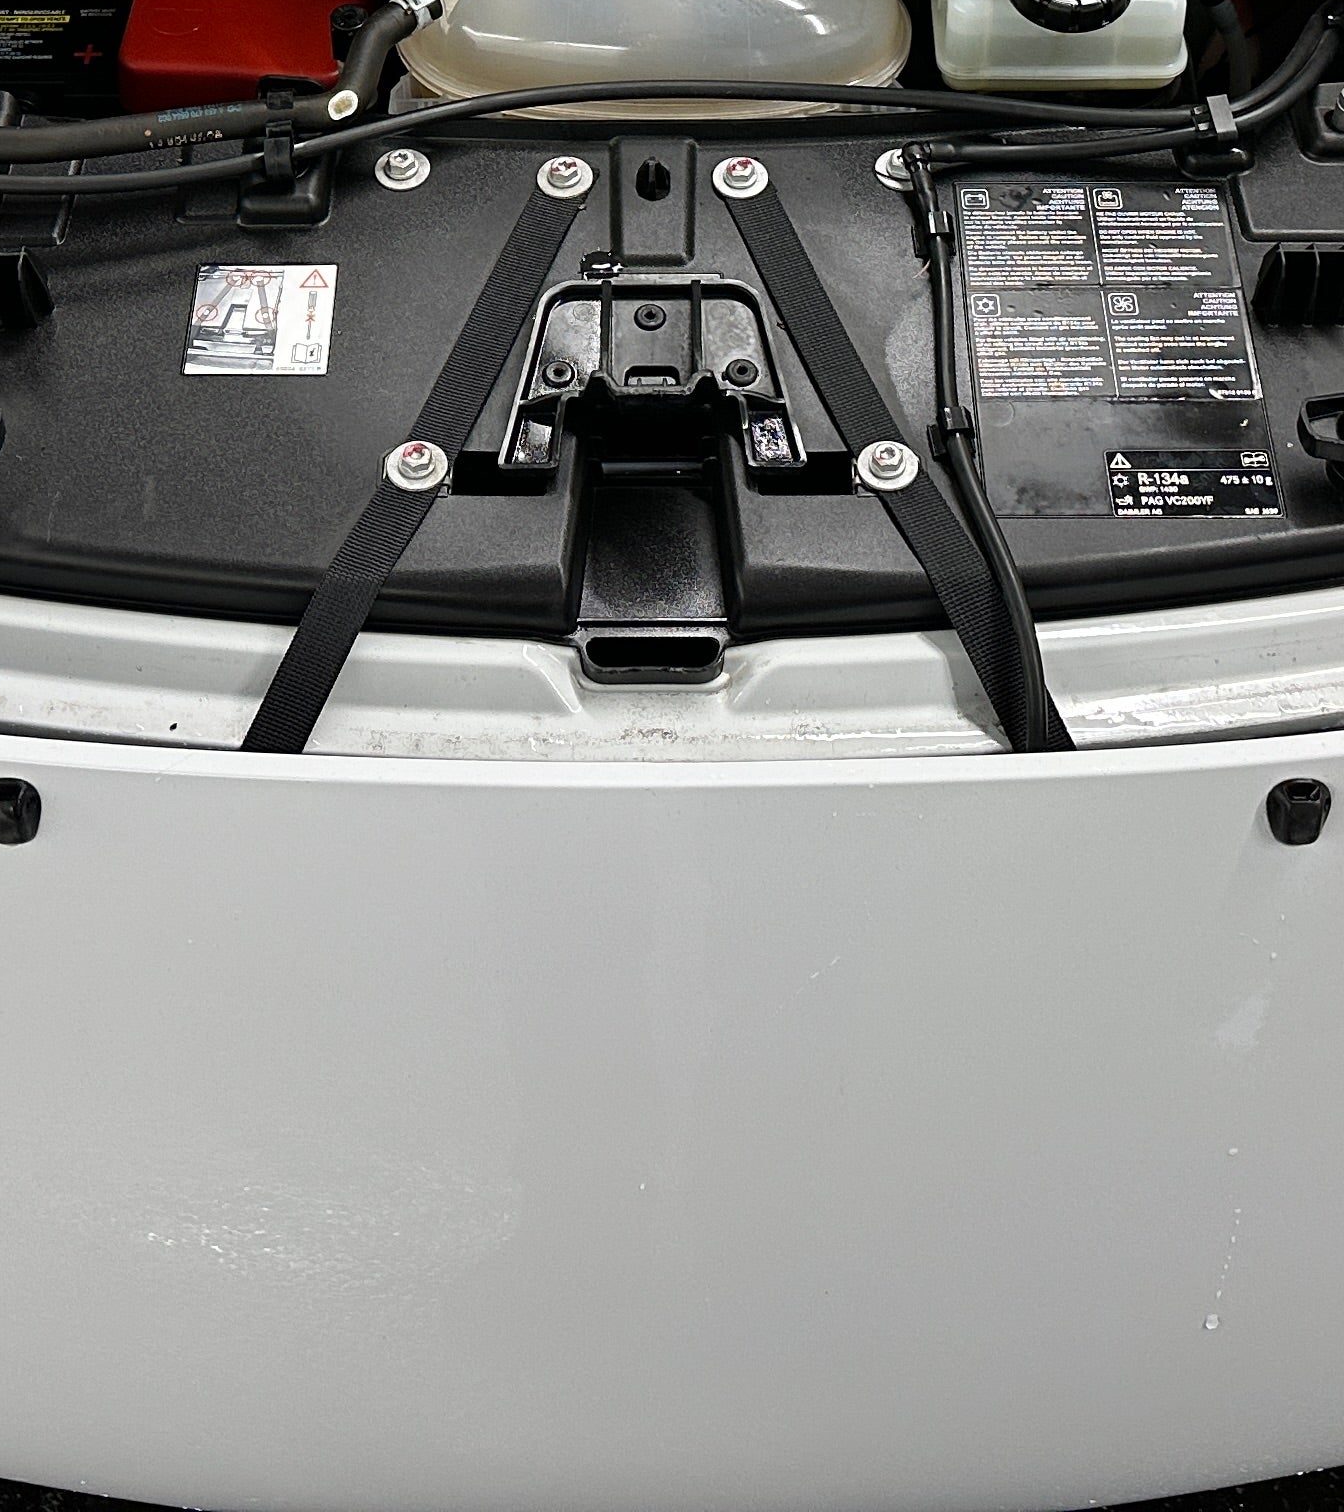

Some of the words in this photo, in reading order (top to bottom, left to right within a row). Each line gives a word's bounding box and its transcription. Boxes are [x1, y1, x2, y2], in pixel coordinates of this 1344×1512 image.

[1137, 472, 1190, 485] R-134a
[1220, 475, 1240, 485] 475
[1251, 475, 1264, 484] 10
[1141, 496, 1164, 506] PAG
